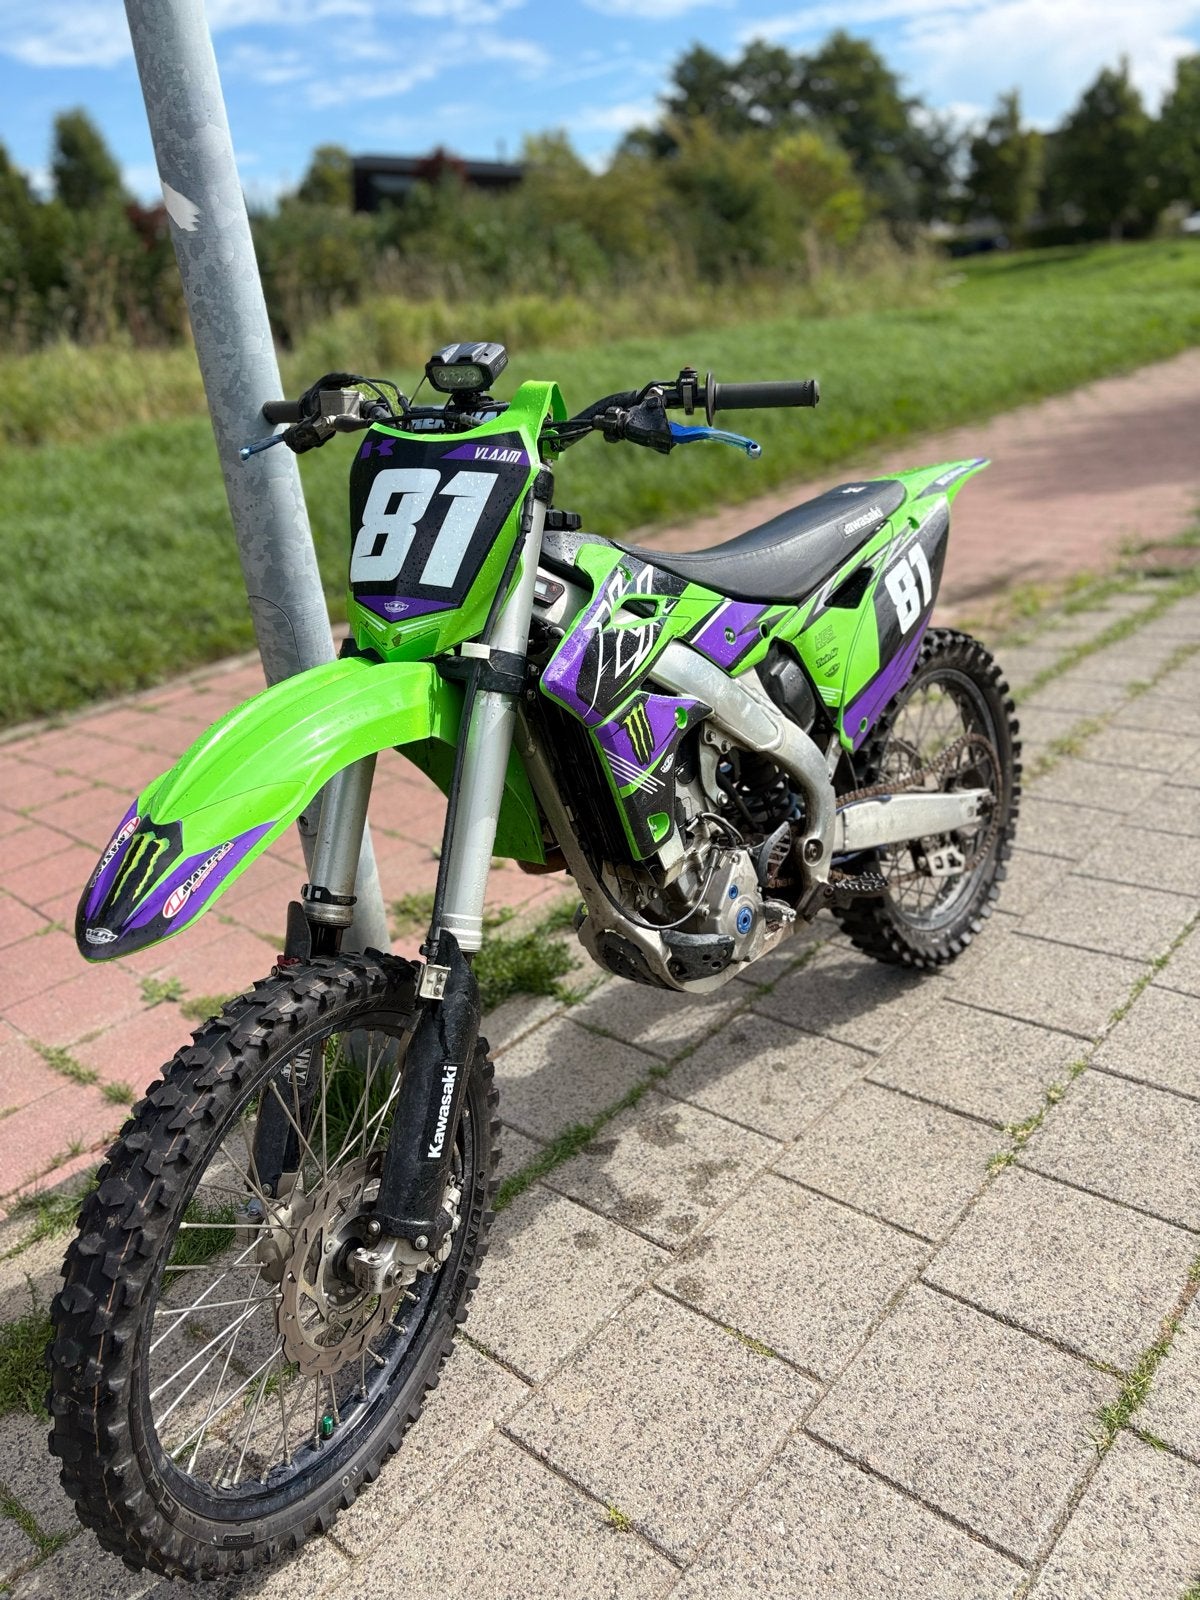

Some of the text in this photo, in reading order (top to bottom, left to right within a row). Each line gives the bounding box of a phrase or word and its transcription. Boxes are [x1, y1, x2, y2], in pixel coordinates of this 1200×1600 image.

[474, 447, 522, 463] VLAAM
[350, 468, 499, 589] 81
[884, 542, 933, 635] 81
[427, 1065, 458, 1159] Kawasaki
